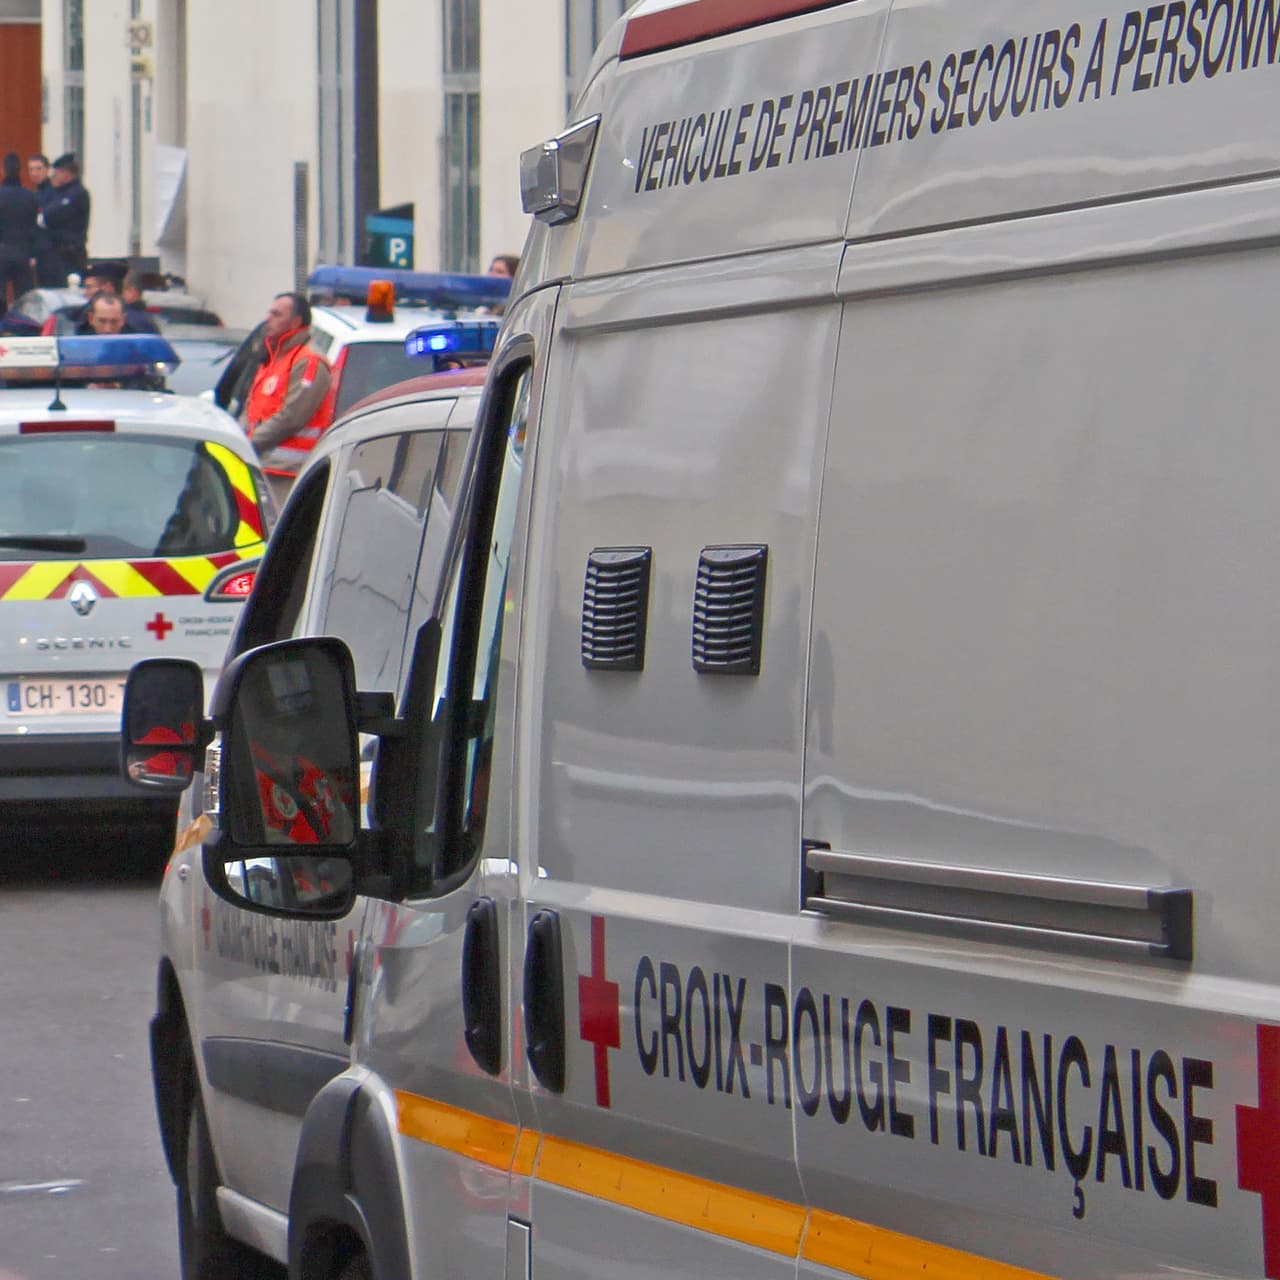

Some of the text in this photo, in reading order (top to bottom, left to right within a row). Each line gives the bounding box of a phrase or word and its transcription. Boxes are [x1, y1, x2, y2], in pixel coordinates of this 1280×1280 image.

[634, 103, 754, 194] VEHICULE
[748, 94, 794, 172] DE
[788, 59, 932, 164] PREMIERS
[930, 22, 1081, 135] SECOURS
[1078, 18, 1108, 103] A
[634, 955, 1218, 1221] CROIX-ROUGE FRANÇAISE
